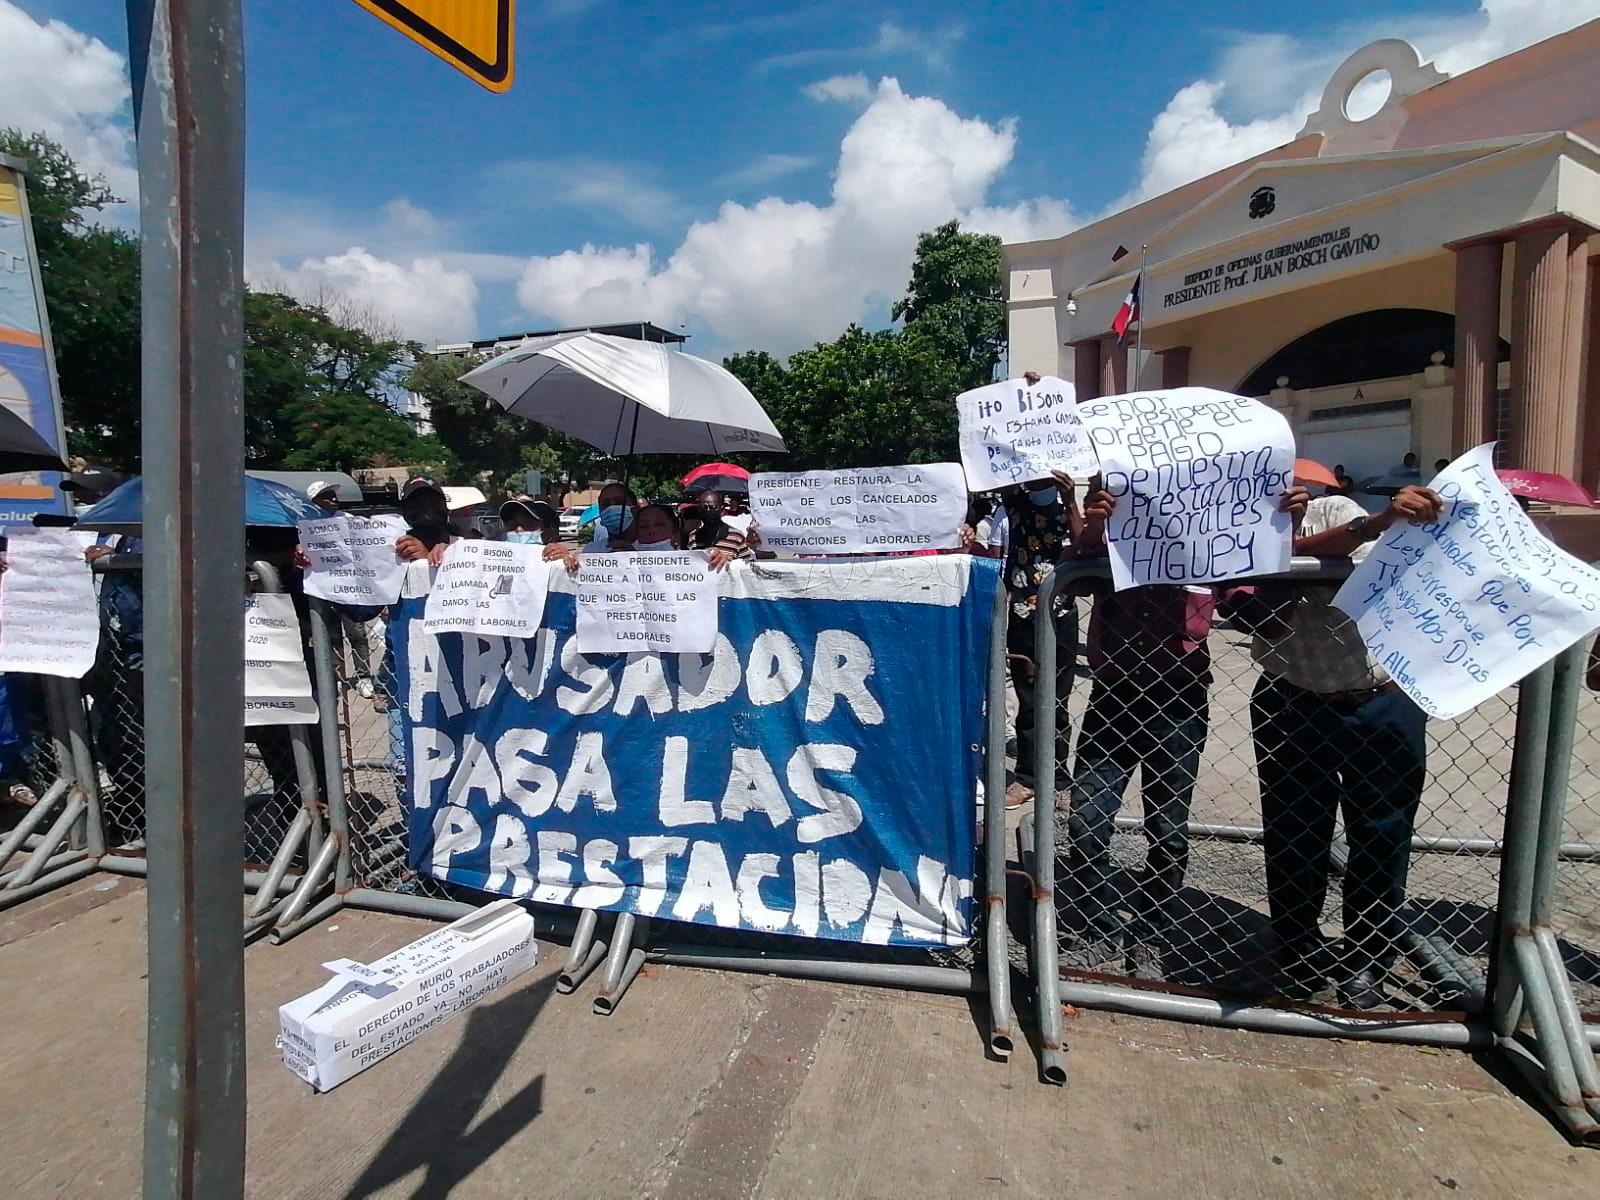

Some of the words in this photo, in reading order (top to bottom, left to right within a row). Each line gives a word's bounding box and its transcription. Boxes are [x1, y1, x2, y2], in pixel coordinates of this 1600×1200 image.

[1215, 265, 1225, 276] DE
[1227, 253, 1262, 272] OFICINAS
[1265, 226, 1351, 261] GUBERNAMENTALES
[1163, 280, 1221, 308] PRESIDENTE
[1224, 273, 1249, 291] Prof.
[1253, 262, 1284, 282] JUAN
[1287, 247, 1328, 273] BOSCH
[1330, 232, 1381, 260] GAVIÑO
[756, 478, 821, 489] PRESIDENTE
[834, 475, 892, 485] RESTAURA
[907, 474, 922, 484] LA
[759, 498, 782, 507] VIDA
[800, 497, 815, 506] DE
[830, 496, 852, 505] LOS
[862, 494, 938, 504] CANCELADOS
[780, 517, 832, 527] PAGANOS
[855, 515, 876, 524] LAS
[767, 535, 847, 546] PRESTACIONES
[865, 534, 932, 545] LABORALES
[463, 546, 479, 554] ITO
[442, 561, 477, 573] ESTAMOS
[482, 564, 526, 574] ESPERANDO
[585, 557, 619, 568] SEÑOR
[629, 556, 691, 566] PRESIDENTE
[579, 574, 614, 583] DIGALE
[621, 574, 629, 583] A
[638, 574, 652, 583] ITO
[451, 580, 489, 590] LLAMADA
[442, 598, 470, 608] DANOS
[475, 601, 490, 609] LAS
[578, 594, 598, 603] QUE
[606, 594, 627, 603] NOS
[635, 592, 667, 602] PAGUE
[676, 592, 697, 602] LAS
[424, 618, 476, 628] PRESTACIONES
[480, 618, 528, 628] LABORALES
[606, 611, 678, 623] PRESTACIONES
[247, 635, 269, 645] 2020
[616, 631, 671, 643] LABORALES
[244, 660, 273, 668] IBIDO
[407, 618, 885, 725] ABUSADOR
[659, 735, 863, 844] LAS
[333, 1039, 350, 1053] EL
[358, 1001, 414, 1038] DERECHO
[416, 992, 431, 1006] DE
[435, 981, 456, 997] LOS
[459, 938, 531, 983] TRABAJADORES
[351, 1043, 374, 1059] DEL
[380, 1012, 425, 1042] ESTADO
[433, 1000, 448, 1012] YA
[458, 984, 472, 998] NO
[485, 966, 505, 982] HAY
[360, 1014, 444, 1067] PRESTACIONES
[453, 975, 508, 1013] LABORALES
